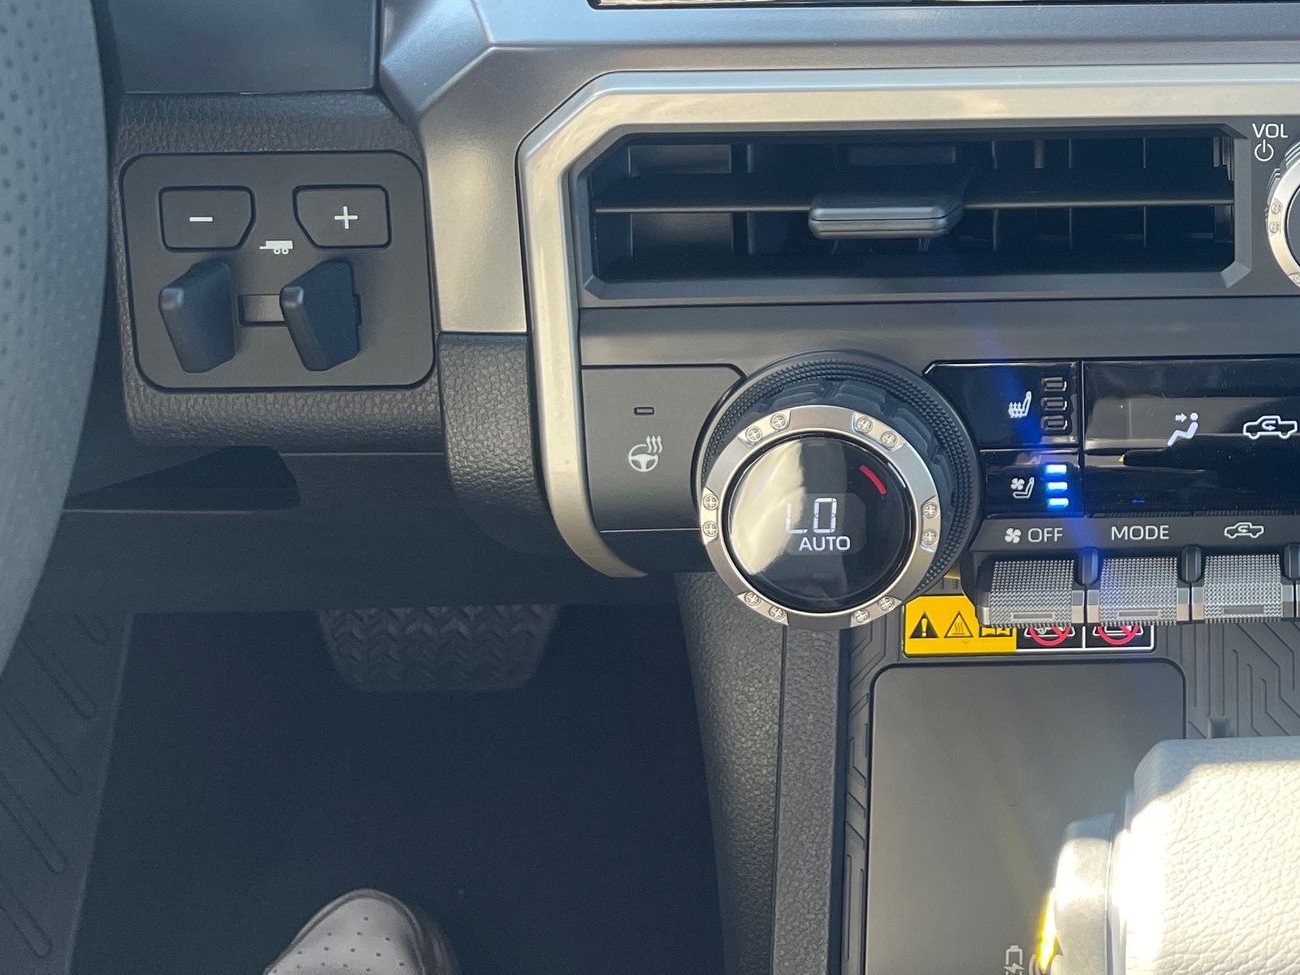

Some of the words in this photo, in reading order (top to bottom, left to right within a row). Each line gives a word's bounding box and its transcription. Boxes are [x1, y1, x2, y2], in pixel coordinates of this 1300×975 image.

[1252, 123, 1288, 139] VOL
[1028, 527, 1063, 543] OFF
[1111, 525, 1170, 541] MODE
[798, 535, 851, 551] AUTO
